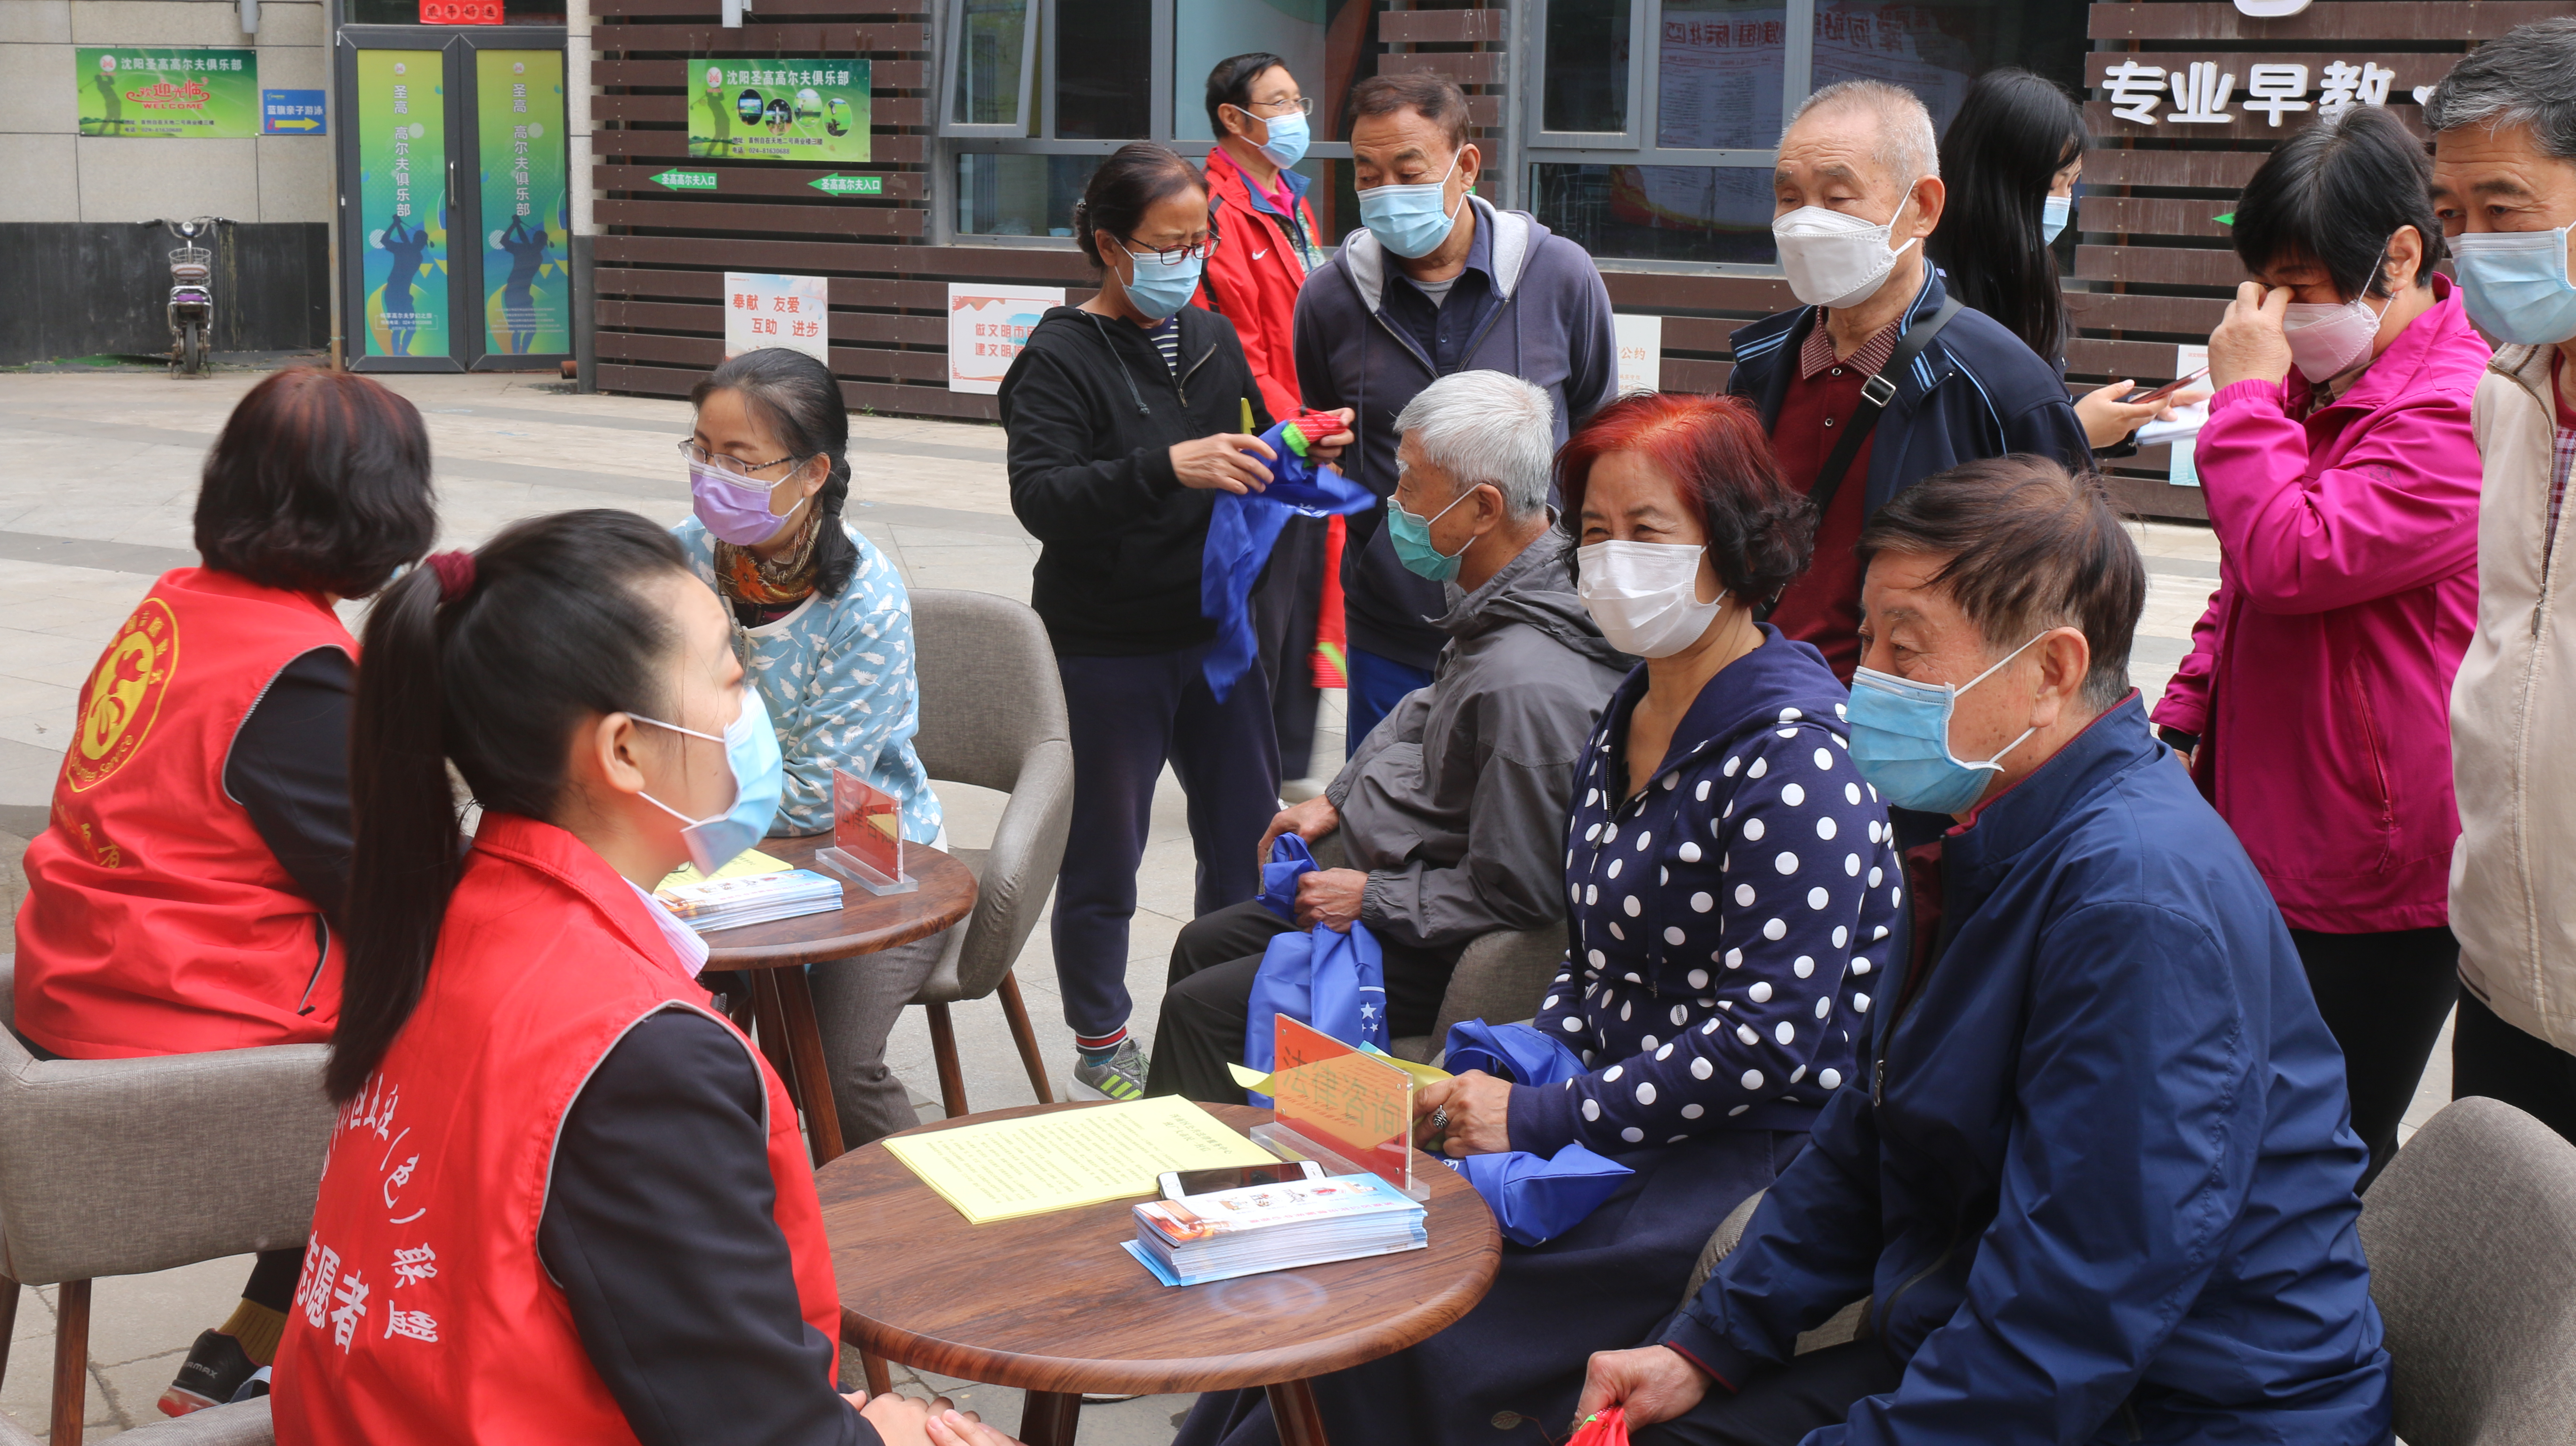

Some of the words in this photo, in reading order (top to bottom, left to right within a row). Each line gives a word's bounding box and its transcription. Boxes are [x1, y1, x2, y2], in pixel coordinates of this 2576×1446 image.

[121, 58, 242, 71] 沈阳圣高高尔夫俱乐部
[727, 71, 850, 86] 沈阳圣高高尔夫俱乐部
[394, 85, 408, 114] 圣高
[513, 84, 527, 113] 圣高
[2102, 60, 2395, 127] 专业早教
[395, 126, 411, 217] 高尔夫俱乐部
[514, 125, 530, 217] 高尔夫俱乐部
[661, 173, 716, 186] 圣高高尔夫入口
[821, 179, 880, 191] 圣高高尔夫入口
[733, 293, 758, 311] 奉献
[773, 296, 800, 313] 友爱
[752, 318, 777, 335] 互助
[792, 320, 819, 337] 进步
[1617, 346, 1646, 361] 公约
[1282, 1045, 1402, 1145] 法律咨询
[297, 1230, 369, 1355] 志愿者
